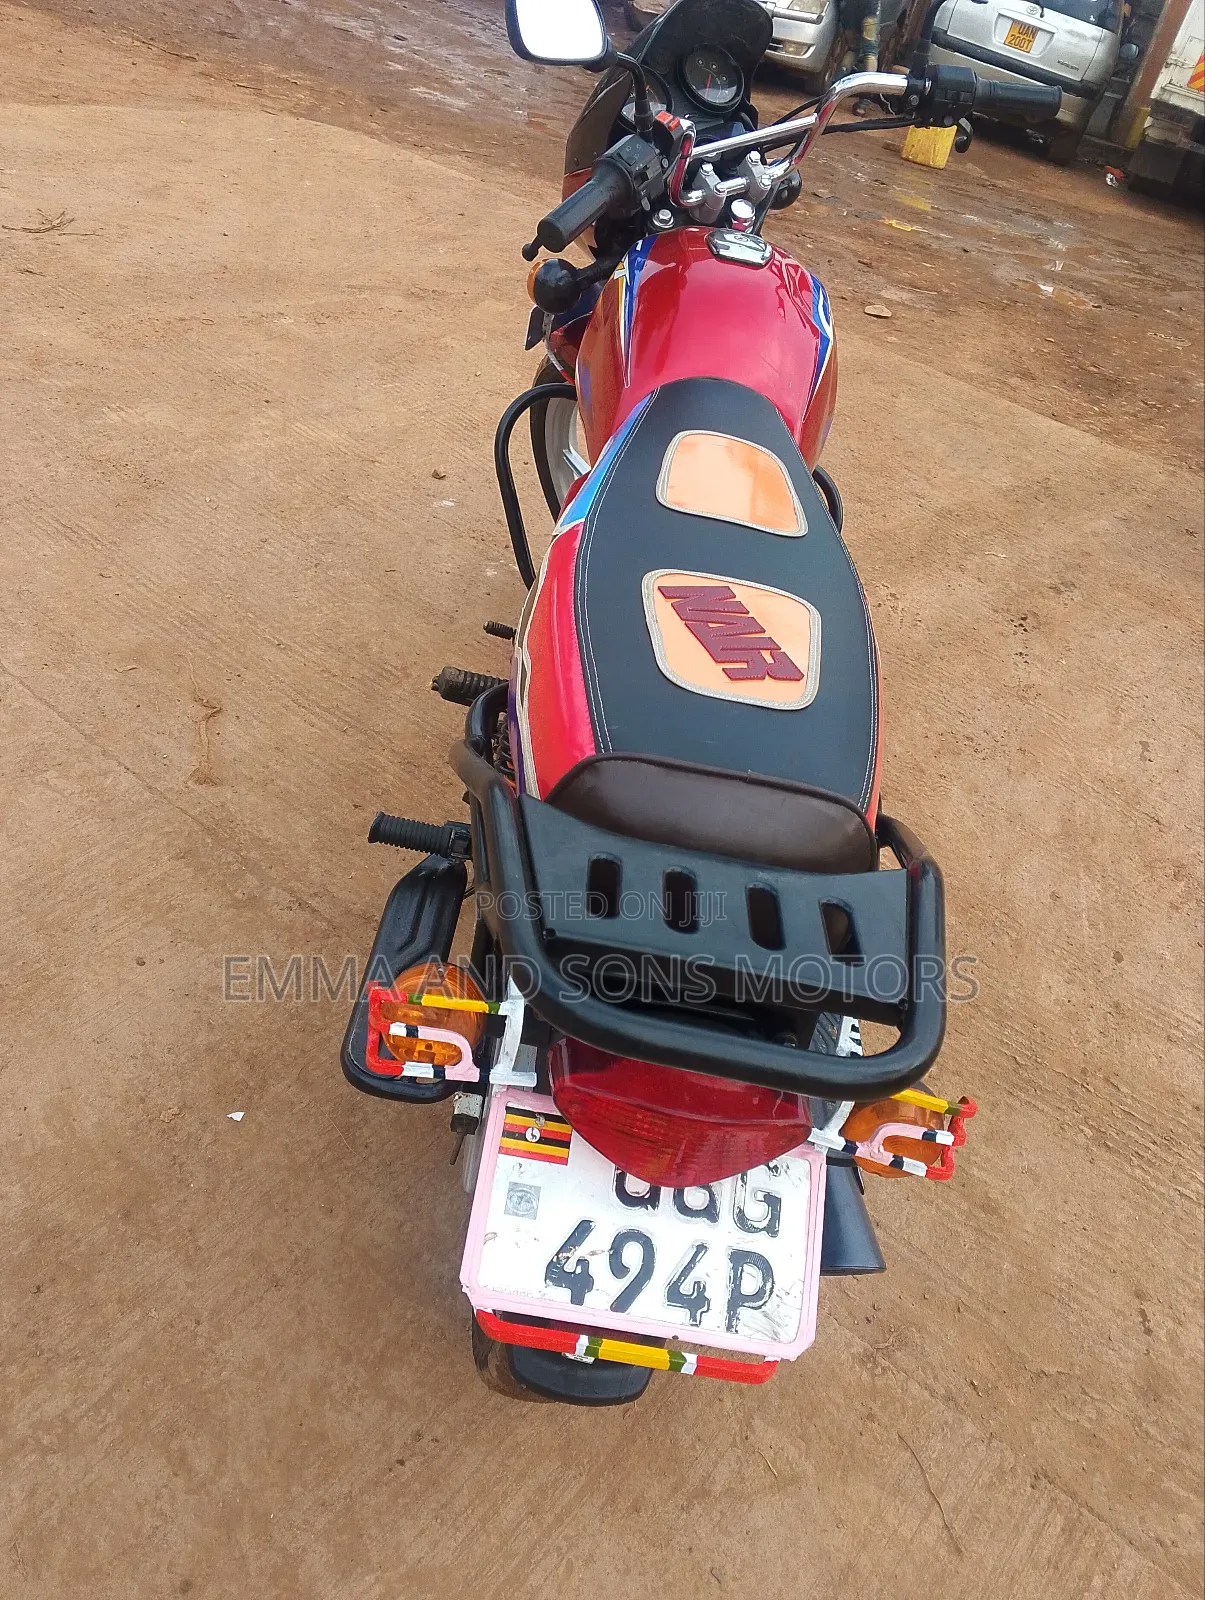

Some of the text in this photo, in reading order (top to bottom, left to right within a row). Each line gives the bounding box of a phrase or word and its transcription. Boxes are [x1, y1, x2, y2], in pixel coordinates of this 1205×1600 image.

[1017, 22, 1039, 39] UAN
[1008, 34, 1033, 50] 200T
[544, 1218, 775, 1334] 494P
